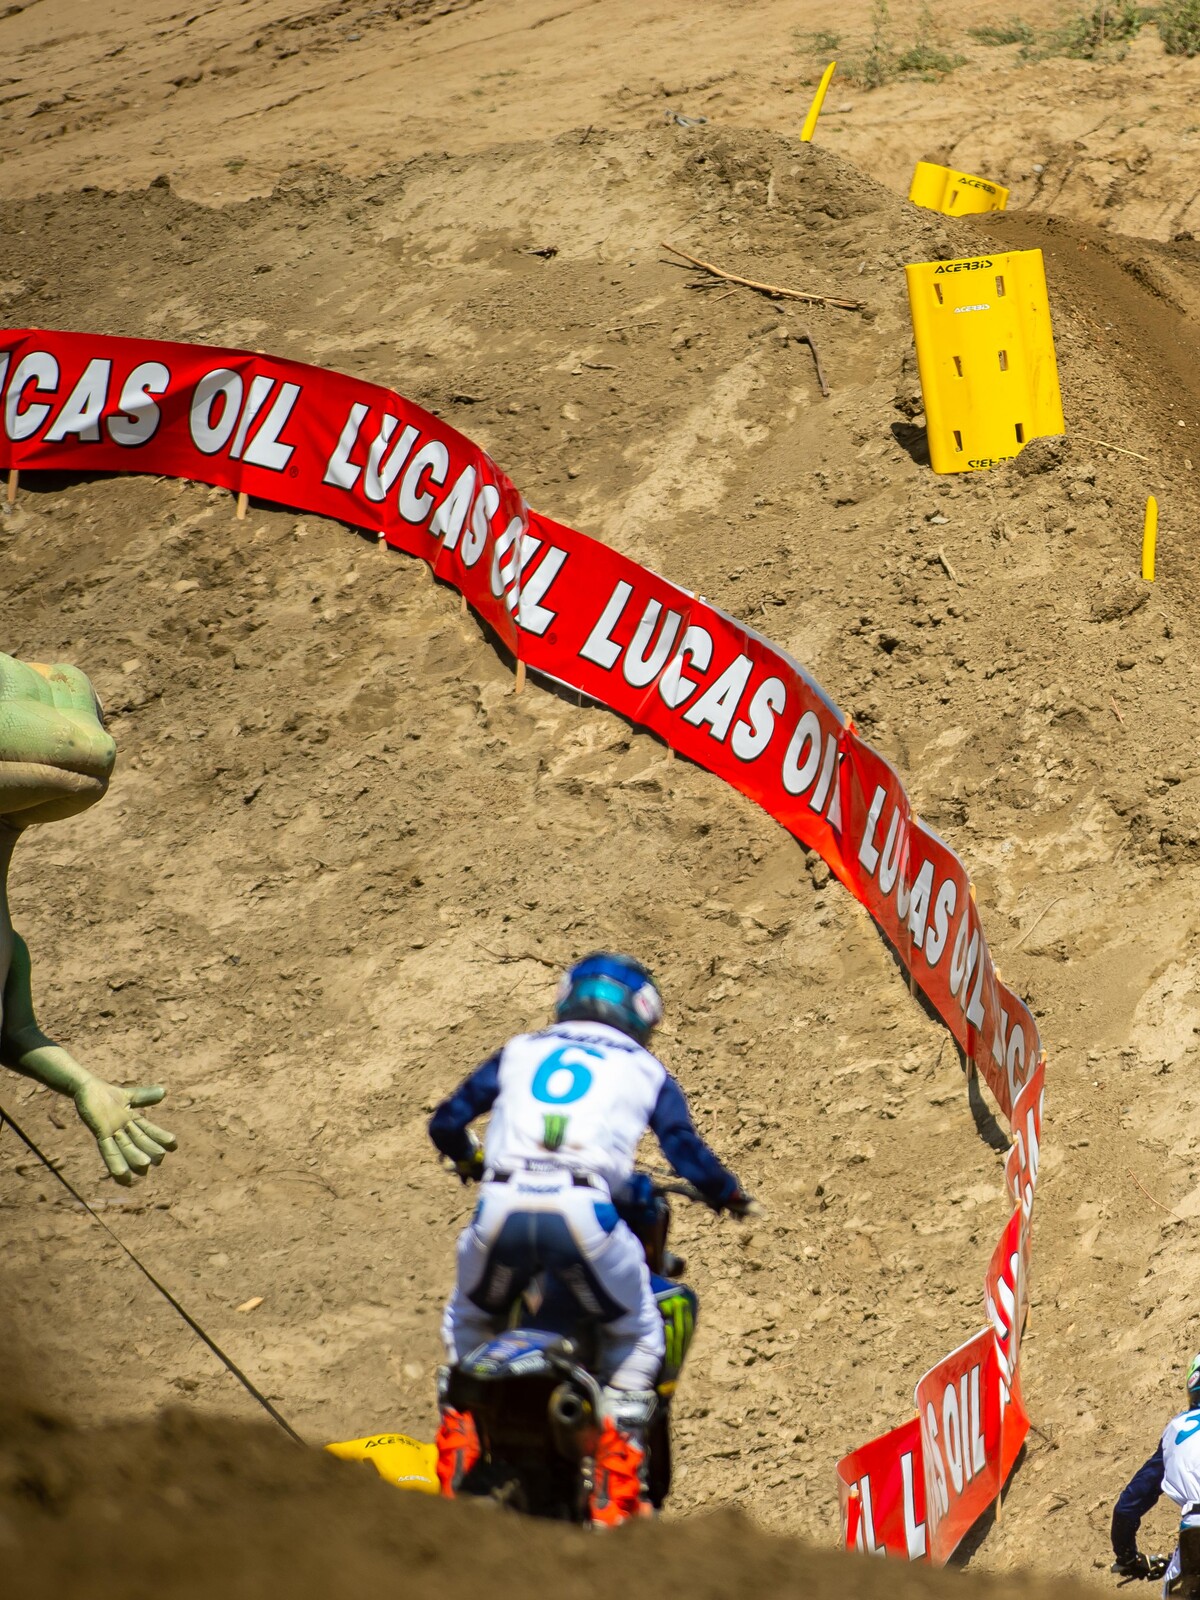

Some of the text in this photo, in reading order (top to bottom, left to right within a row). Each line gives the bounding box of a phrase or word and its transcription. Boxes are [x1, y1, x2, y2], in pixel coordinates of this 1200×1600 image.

[0, 351, 171, 448] CAS
[189, 367, 302, 471] OIL
[322, 402, 500, 569] LUCAS
[490, 514, 570, 638] OIL
[579, 579, 787, 763] LUCAS
[858, 784, 957, 969] LUCAS
[531, 1044, 605, 1104] 6
[942, 1364, 986, 1496] OIL
